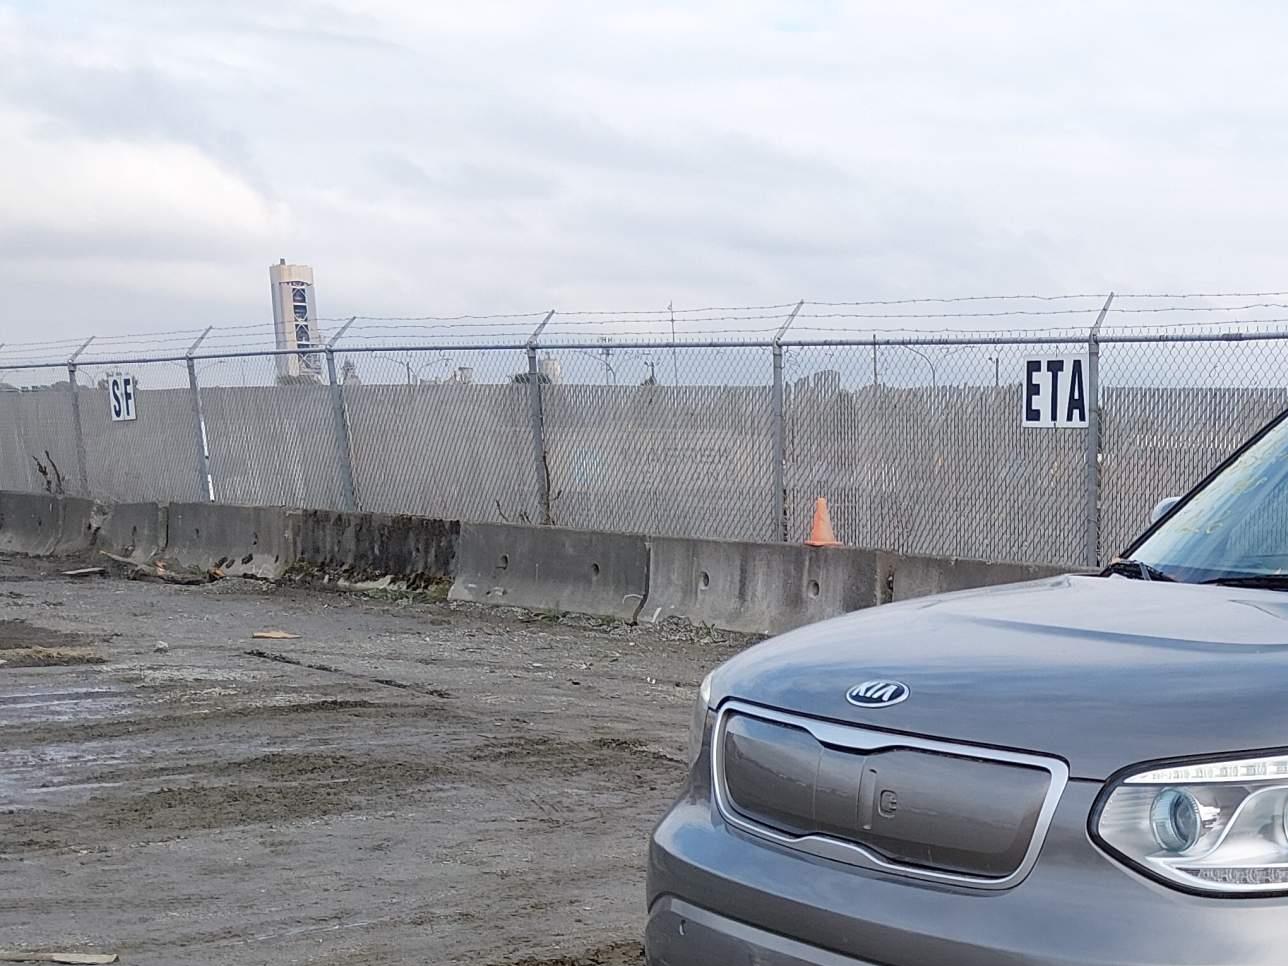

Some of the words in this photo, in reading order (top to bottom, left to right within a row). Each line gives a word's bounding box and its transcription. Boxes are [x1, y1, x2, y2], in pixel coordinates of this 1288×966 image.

[111, 378, 132, 418] SF
[1025, 359, 1086, 422] ETA
[850, 680, 899, 702] KIA
